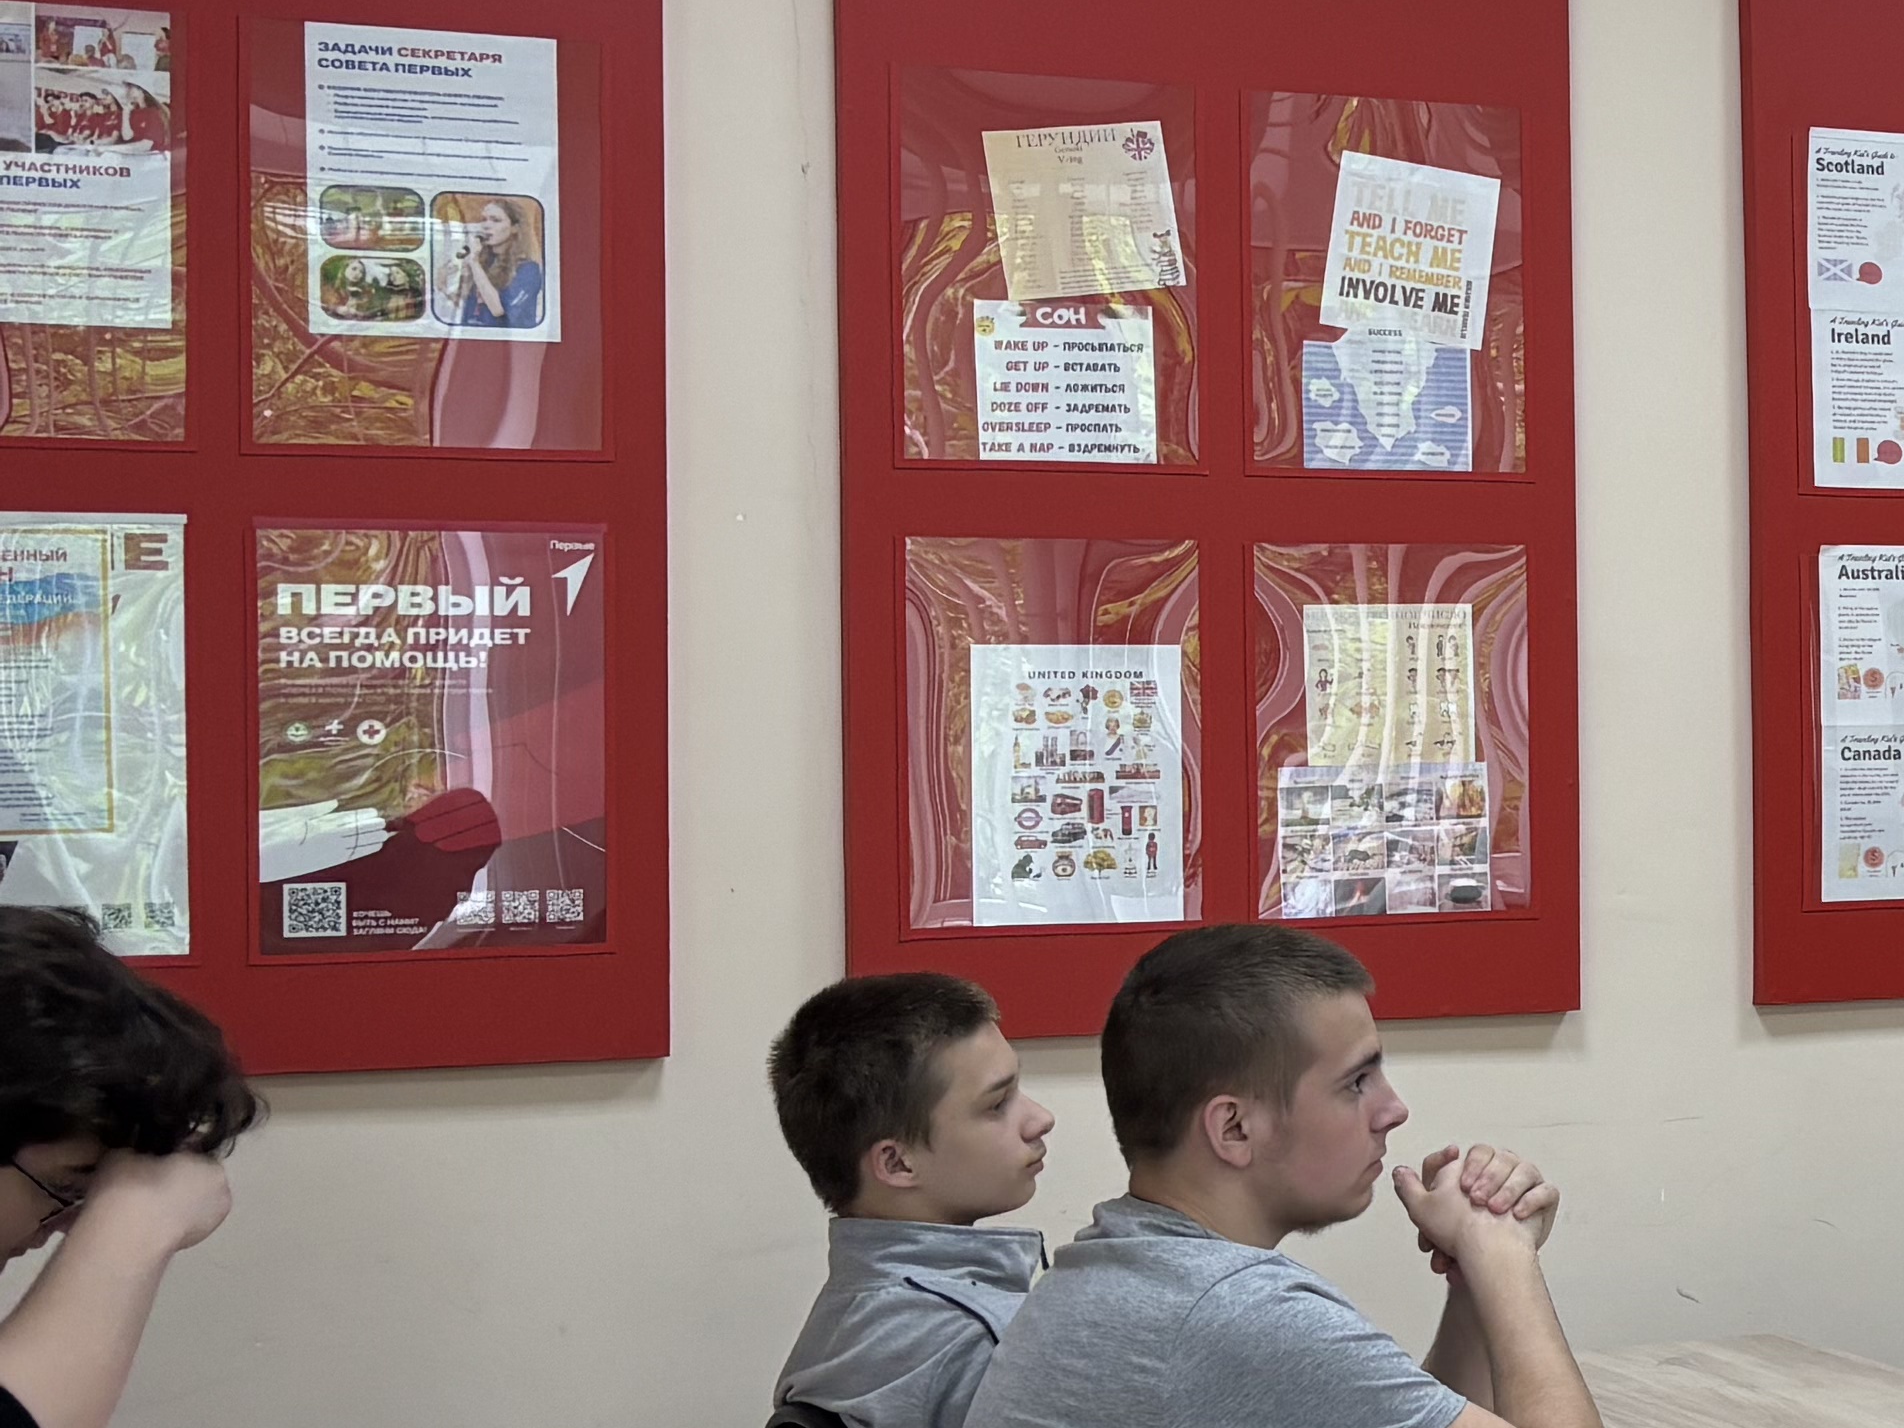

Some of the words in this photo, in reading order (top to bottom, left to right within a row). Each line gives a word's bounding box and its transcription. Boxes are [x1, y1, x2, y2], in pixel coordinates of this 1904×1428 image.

[318, 41, 393, 57] ЗАДАЧИ
[397, 47, 503, 64] СЕКРЕТАРЯ
[317, 58, 391, 73] СОВЕТА
[394, 63, 473, 78] ПЕРВЫХ
[3, 160, 131, 178] УЧАСТНИКОВ
[1816, 156, 1885, 175] Scotland
[0, 175, 81, 189] ПЕРВЫХ
[1350, 210, 1383, 230] AND
[1390, 217, 1397, 234] I
[1403, 219, 1468, 245] FORGET
[1345, 230, 1423, 264] TEACH
[1429, 246, 1463, 273] ME
[1343, 258, 1372, 274] AND
[1388, 265, 1463, 291] REMEMBER
[1339, 276, 1425, 310] INVOLVE
[1431, 292, 1461, 315] ME
[1035, 307, 1086, 325] СОН
[1831, 327, 1891, 345] Ireland
[994, 340, 1028, 351] WAKE
[1033, 341, 1049, 351] UP
[1006, 360, 1028, 372] GET
[1034, 361, 1049, 372] UP
[1064, 362, 1121, 373] ВСТАВАТЬ
[1015, 382, 1049, 393] DOWN
[1065, 383, 1125, 394] ЛОЖИТЬСЯ
[991, 402, 1022, 413] DOZE
[1026, 402, 1049, 413] OFF
[1065, 403, 1131, 414] ЗАДРЕМАТЬ
[982, 422, 1051, 433] OVERSLEEP
[1065, 422, 1122, 434] ПРОСПАТЬ
[981, 442, 1012, 453] TAKE
[1017, 443, 1026, 453] A
[1030, 443, 1054, 454] NAP
[0, 546, 68, 563] ЕННЫЙ
[277, 576, 531, 616] ПЕРВЫЙ
[279, 627, 401, 647] ВСЕГДА
[406, 627, 531, 648] ПРИДЕТ
[279, 651, 322, 669] НА
[328, 651, 488, 671] ПОМОЩЬ!
[1028, 670, 1076, 680] UNITED
[1081, 670, 1144, 680] KINGDOM
[1840, 745, 1902, 761] Canada
